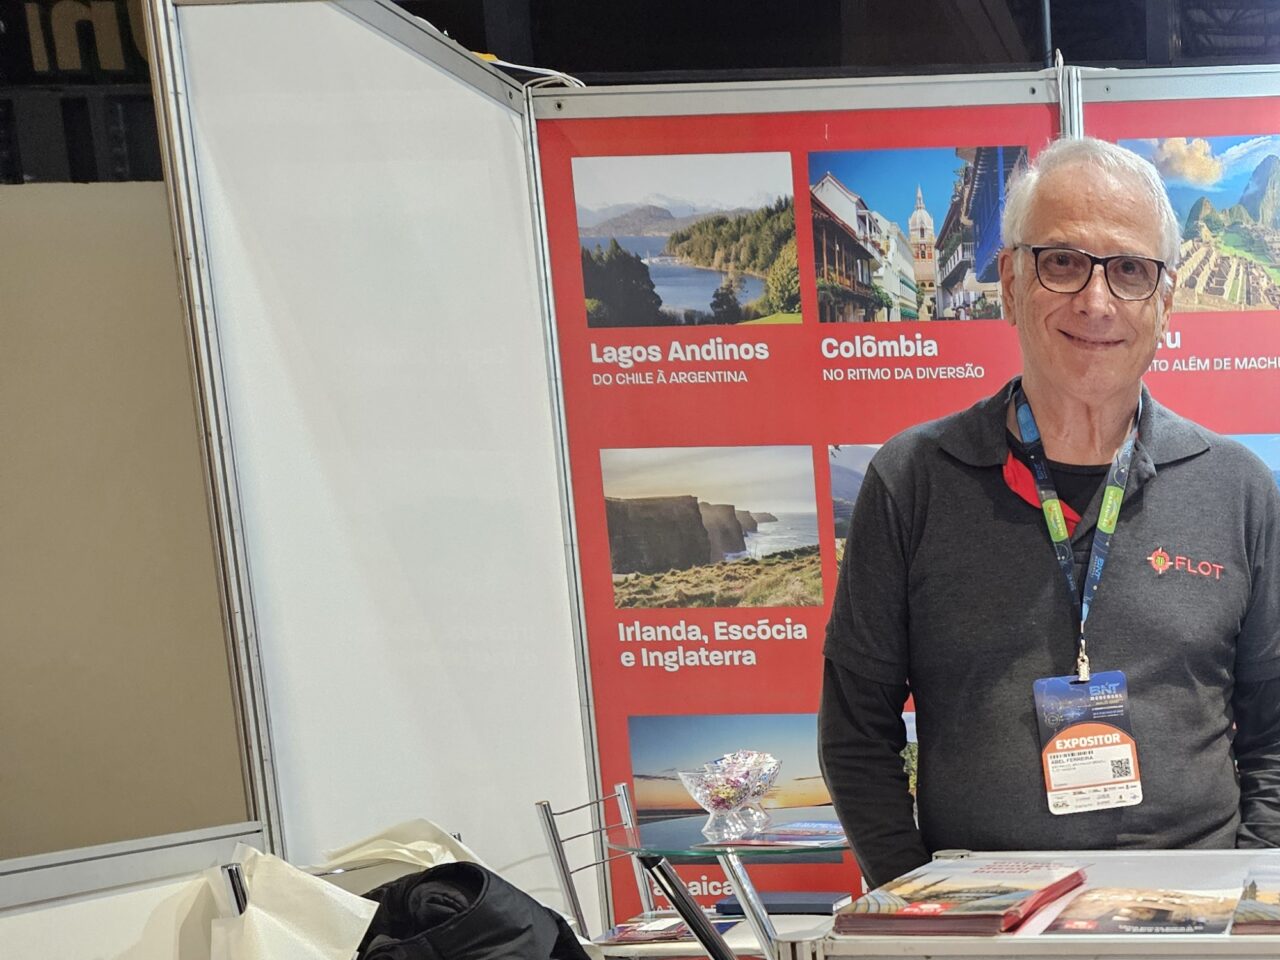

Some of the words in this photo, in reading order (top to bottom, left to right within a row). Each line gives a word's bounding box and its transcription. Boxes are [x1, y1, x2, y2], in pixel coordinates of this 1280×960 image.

[590, 342, 662, 368] Lagos
[668, 337, 770, 361] Andinos
[821, 333, 938, 359] Colômbia
[823, 369, 844, 381] NO
[847, 367, 891, 380] RITMO
[893, 367, 914, 380] DA
[916, 362, 985, 379] DIVERSÃO
[1148, 359, 1169, 372] ITO
[1172, 355, 1210, 371] ALÉM
[1214, 358, 1231, 370] DE
[592, 372, 613, 386] DO
[615, 371, 654, 385] CHILE
[656, 367, 667, 384] À
[669, 369, 748, 384] ARGENTINA
[1175, 555, 1225, 580] FLOT
[618, 621, 709, 644] Irlanda,
[714, 617, 808, 642] Escócia
[620, 649, 636, 668] e
[641, 647, 757, 672] Inglaterra
[1055, 733, 1121, 750] EXPOSITOR
[653, 875, 735, 896] aaica
